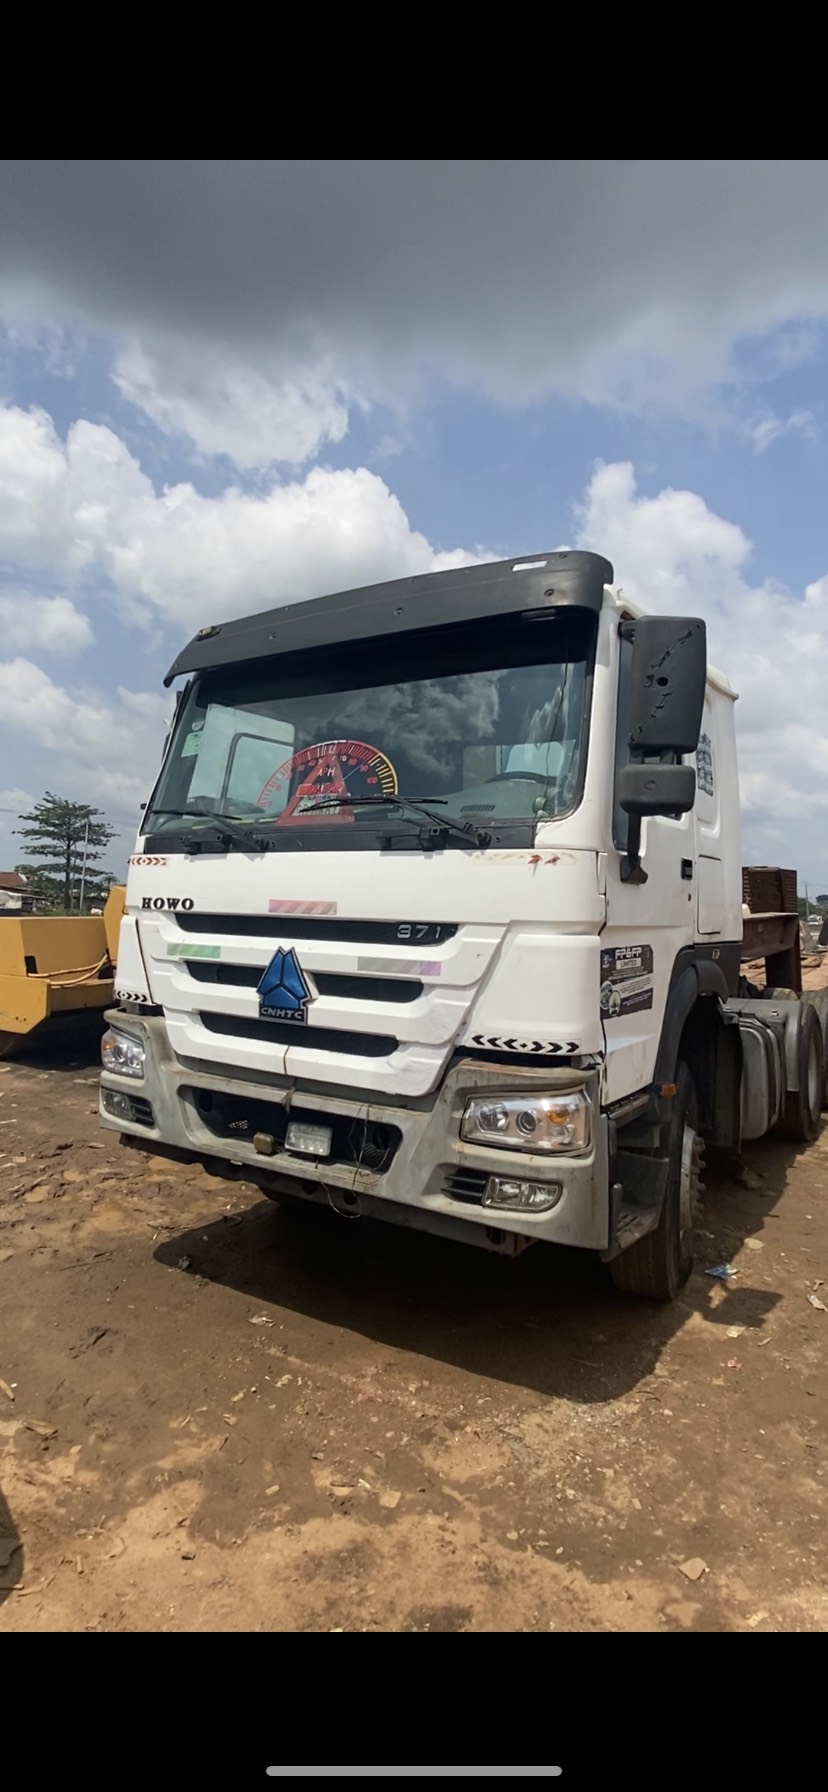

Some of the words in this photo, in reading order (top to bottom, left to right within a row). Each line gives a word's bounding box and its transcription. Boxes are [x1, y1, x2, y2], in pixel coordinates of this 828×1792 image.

[141, 897, 195, 911] HOWO
[396, 924, 441, 940] 371
[260, 1007, 304, 1019] CNHTC
